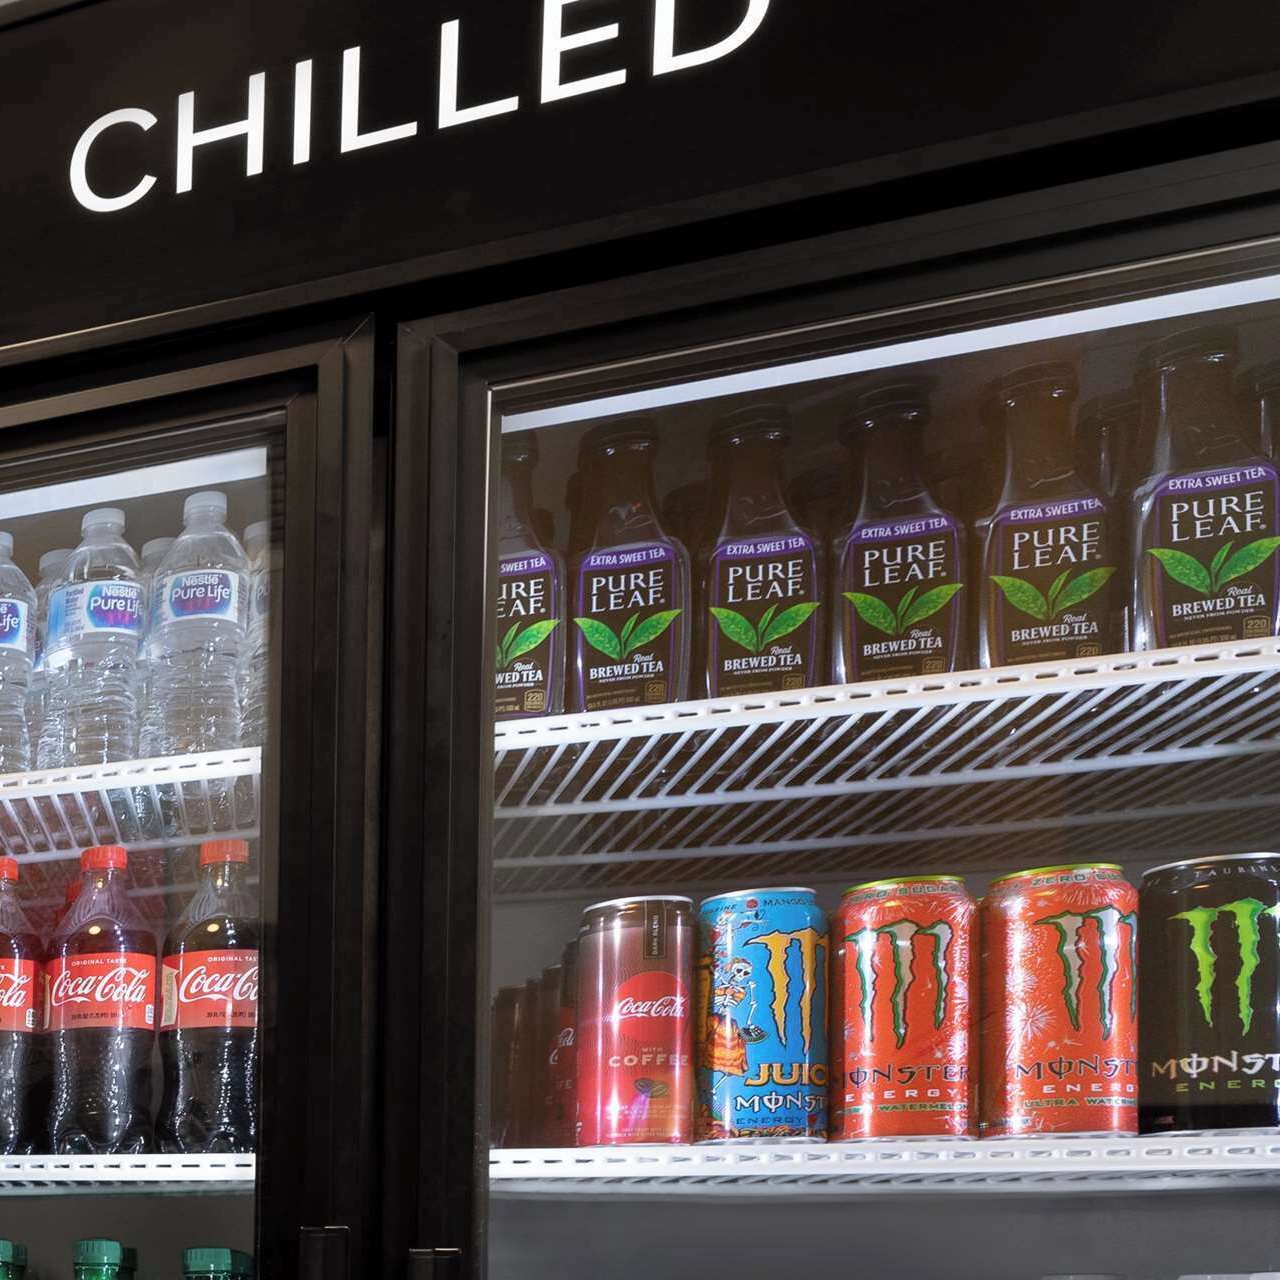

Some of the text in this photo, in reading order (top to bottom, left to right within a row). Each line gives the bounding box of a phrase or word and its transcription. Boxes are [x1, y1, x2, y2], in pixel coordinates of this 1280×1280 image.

[69, 0, 770, 212] CHILLED
[1169, 466, 1266, 491] EXTRA SWEET TEA
[1171, 491, 1264, 524] PURE
[1013, 521, 1100, 550] PURE
[864, 540, 946, 568] PURE
[172, 585, 231, 602] Pure Life
[1227, 584, 1253, 597] Real
[1172, 594, 1266, 617] BREWED TEA
[72, 958, 104, 968] ORIGINAL
[51, 966, 150, 1007] Coca-Cola
[616, 994, 686, 1018] Coca-Cola
[609, 1054, 688, 1068] COFFEE
[846, 1089, 962, 1102] ENERGY
